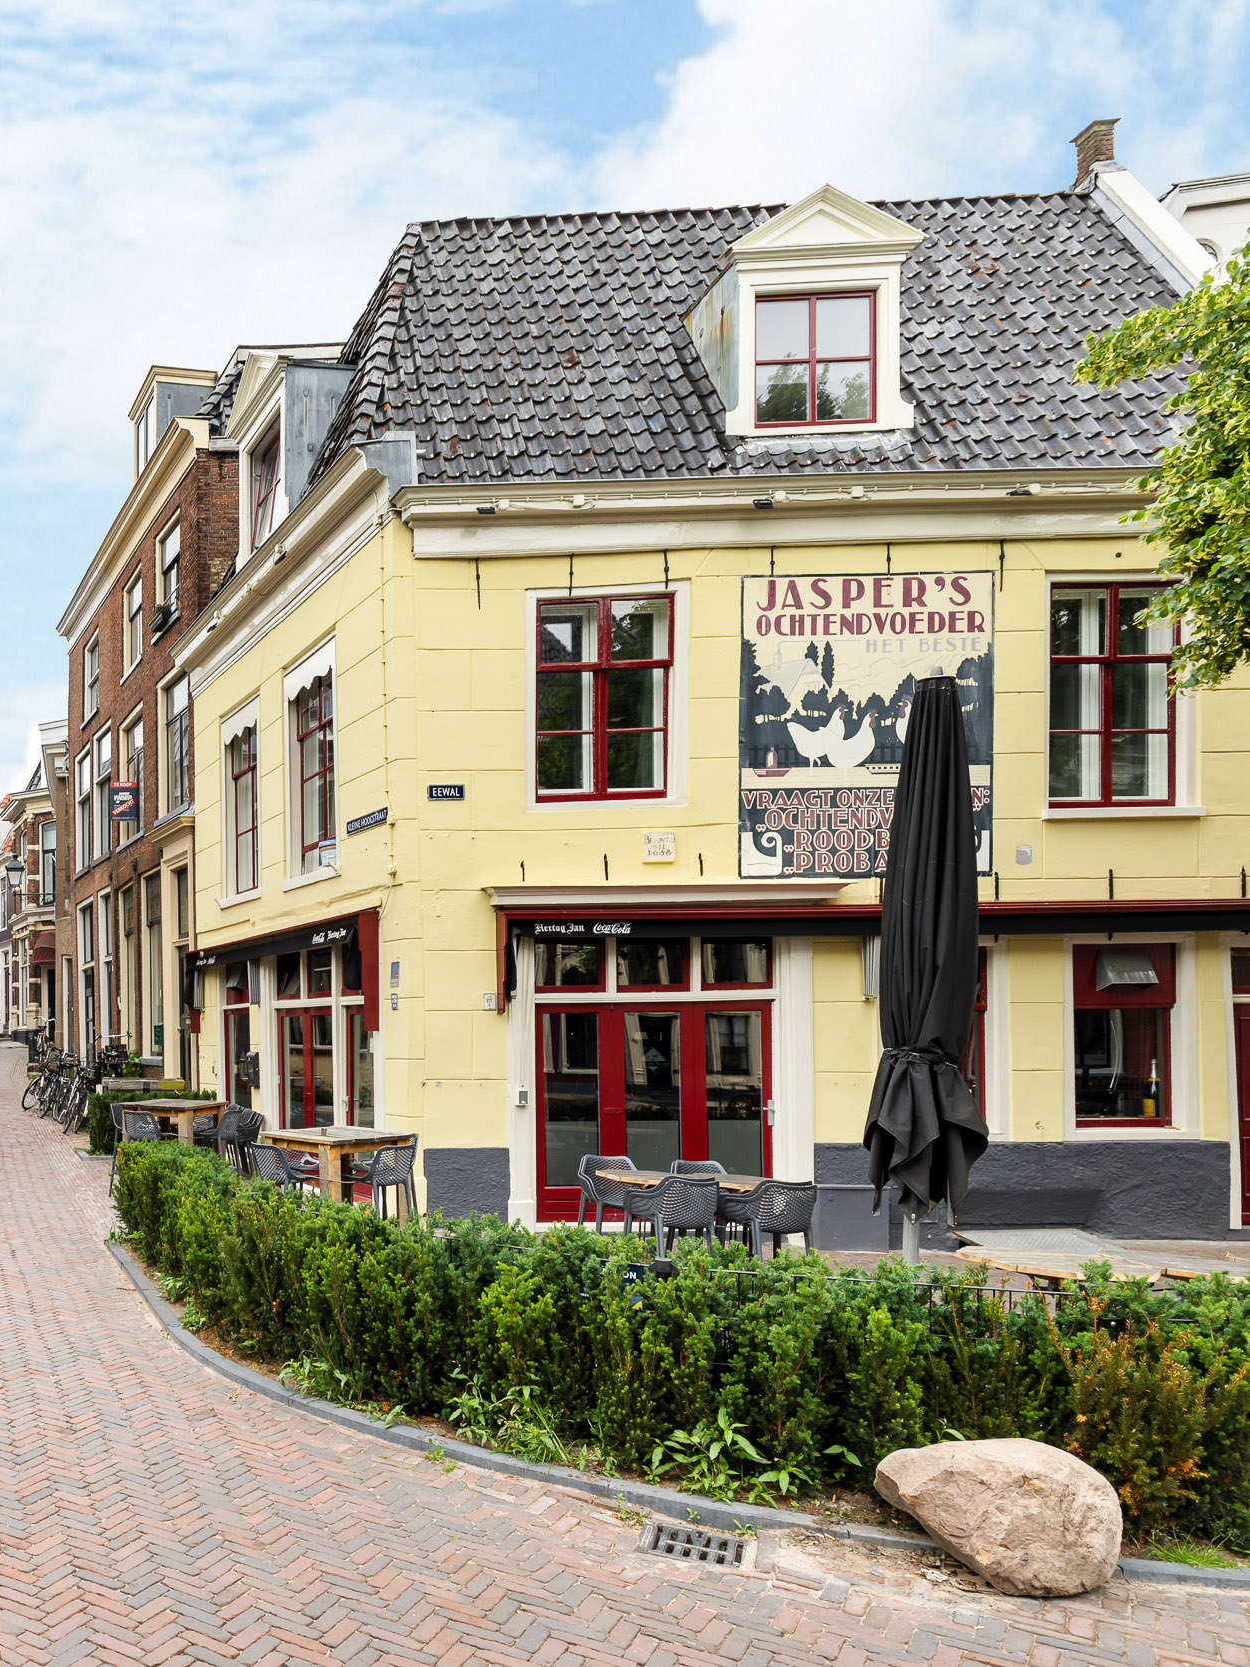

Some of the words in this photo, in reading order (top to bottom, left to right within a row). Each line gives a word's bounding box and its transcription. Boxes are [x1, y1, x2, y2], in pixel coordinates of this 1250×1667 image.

[756, 575, 972, 612] JASPER'S
[756, 611, 986, 637] OCHTENDVOEDER
[865, 639, 907, 653] HET
[919, 637, 982, 652] BESTE
[432, 787, 460, 797] EEWAL
[741, 790, 834, 809] VRAAGT
[836, 789, 895, 808] ONZE
[347, 819, 361, 832] KLEINE
[534, 923, 567, 934] Hertog
[566, 923, 585, 934] Jan
